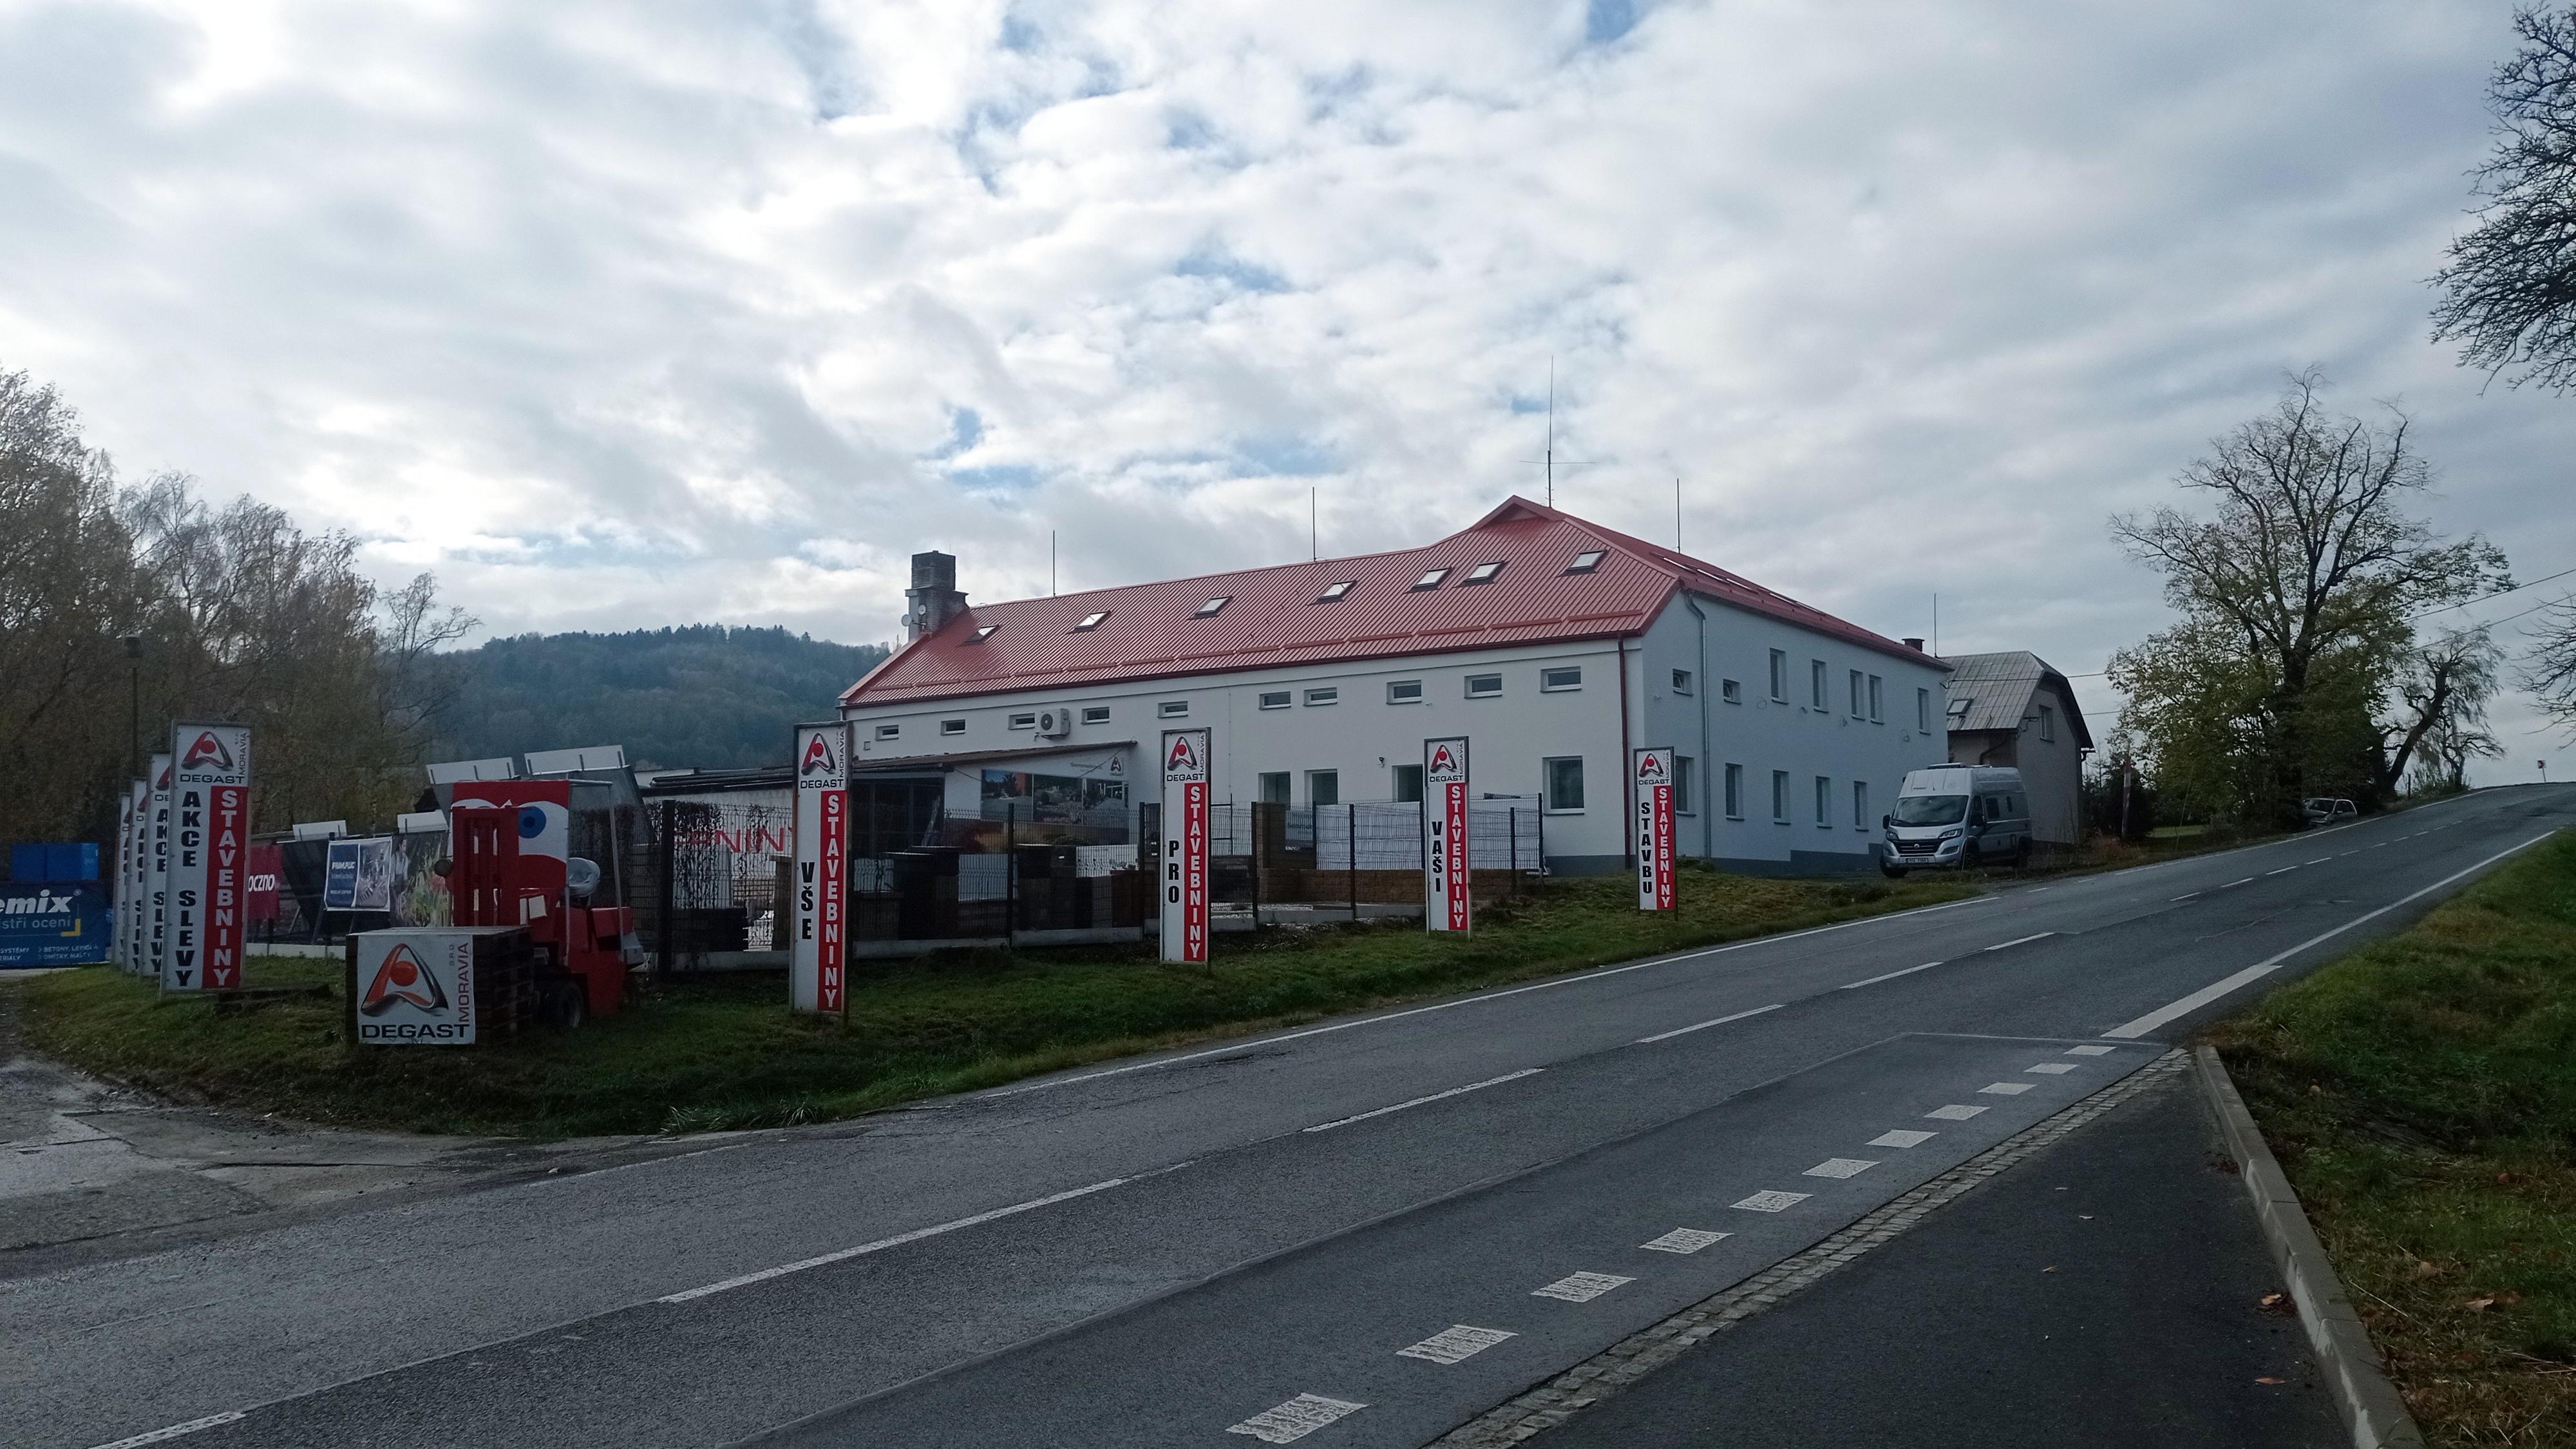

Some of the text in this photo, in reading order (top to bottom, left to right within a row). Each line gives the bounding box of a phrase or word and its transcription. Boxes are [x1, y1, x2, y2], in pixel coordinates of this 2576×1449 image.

[180, 774, 245, 784] DEGAST
[800, 779, 844, 789] DEGAST
[1166, 773, 1204, 782] DEGAST
[1168, 840, 1179, 904] PRO
[1189, 785, 1201, 958] STAVEBNINY
[1432, 821, 1443, 892] VAŠI
[1451, 785, 1463, 928] STAVEBNINY
[1641, 802, 1653, 894] STAVBU
[1659, 788, 1671, 907] STAVEBNINY
[32, 915, 71, 928] ocení
[176, 791, 201, 987] AKCE SLEVY
[213, 790, 238, 986] STAVEBNINY
[800, 862, 815, 940] VŠE
[824, 794, 839, 1008] STAVEBNINY
[458, 942, 469, 1022] MORAVIA
[361, 1024, 470, 1038] DEGAST
